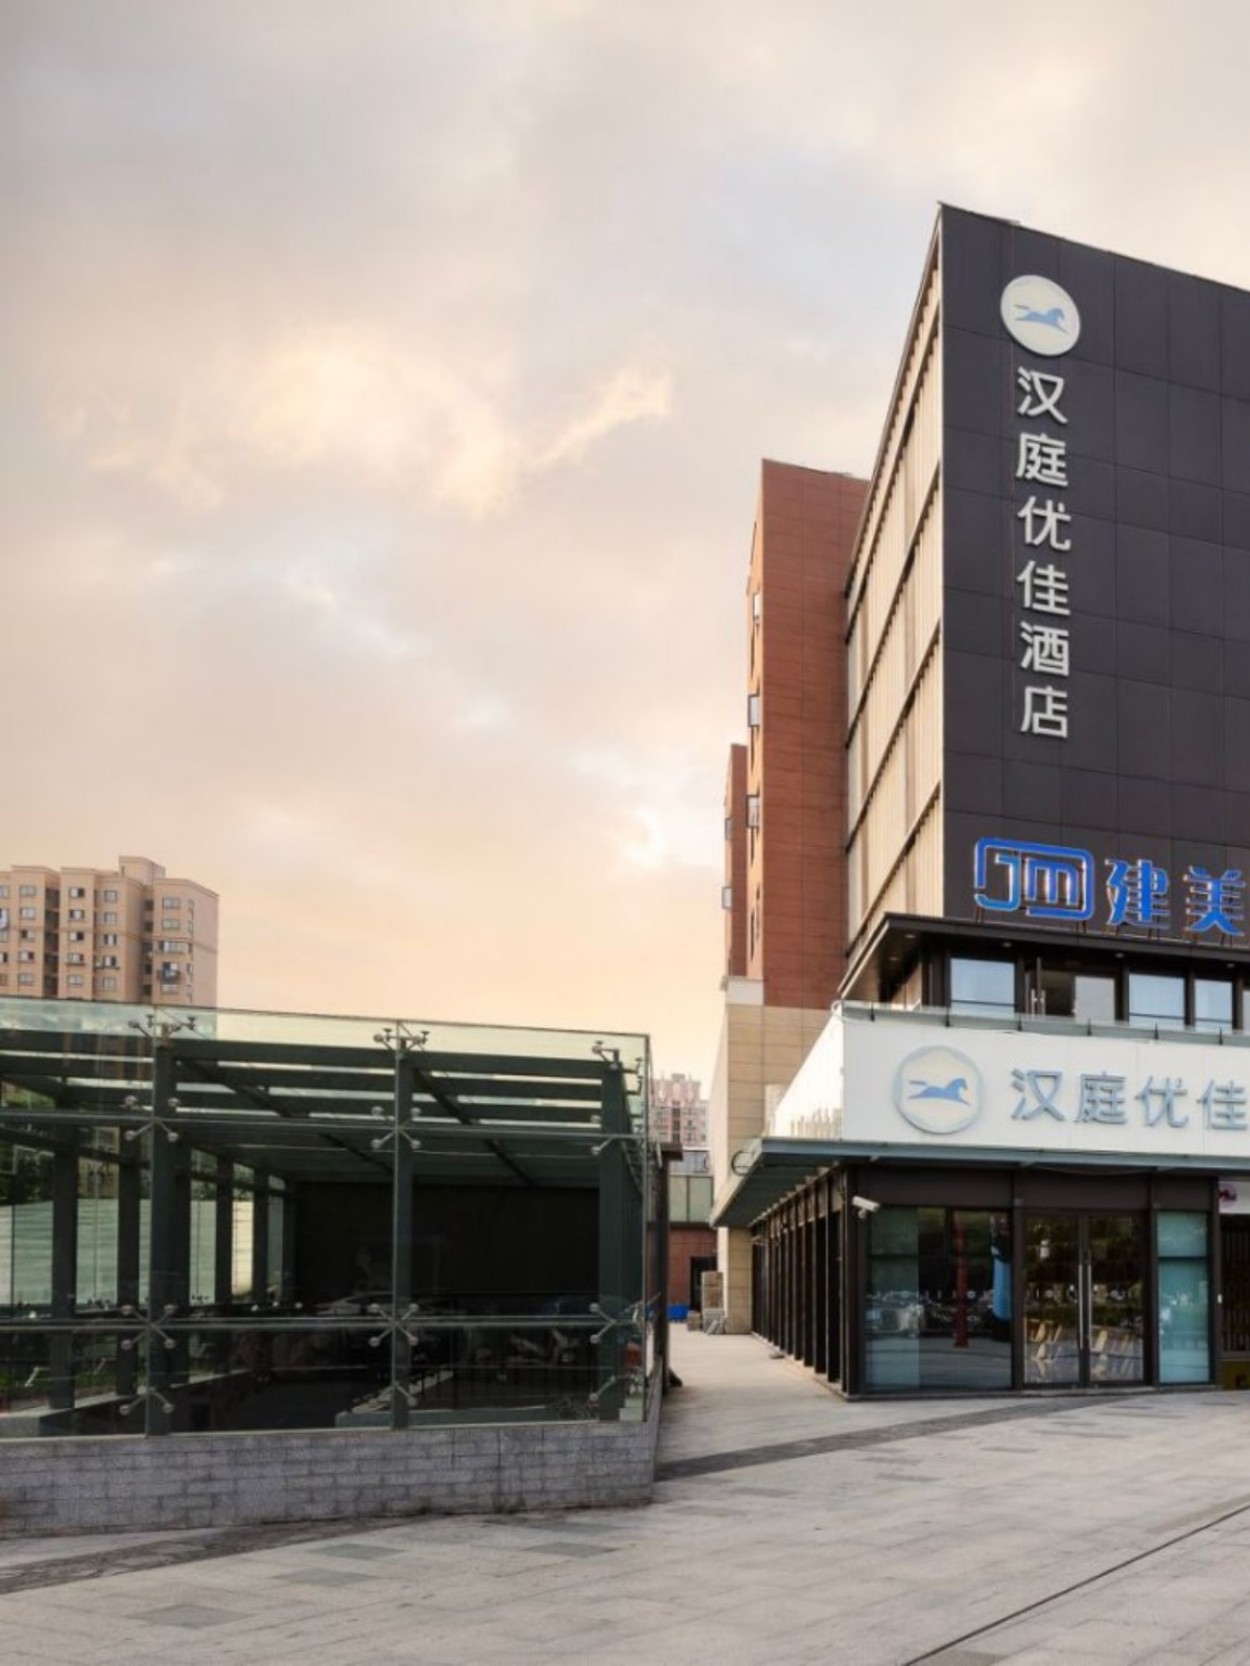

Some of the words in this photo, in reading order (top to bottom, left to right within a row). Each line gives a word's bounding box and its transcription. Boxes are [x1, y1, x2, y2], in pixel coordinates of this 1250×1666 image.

[1015, 366, 1072, 739] 汉庭优佳酒店
